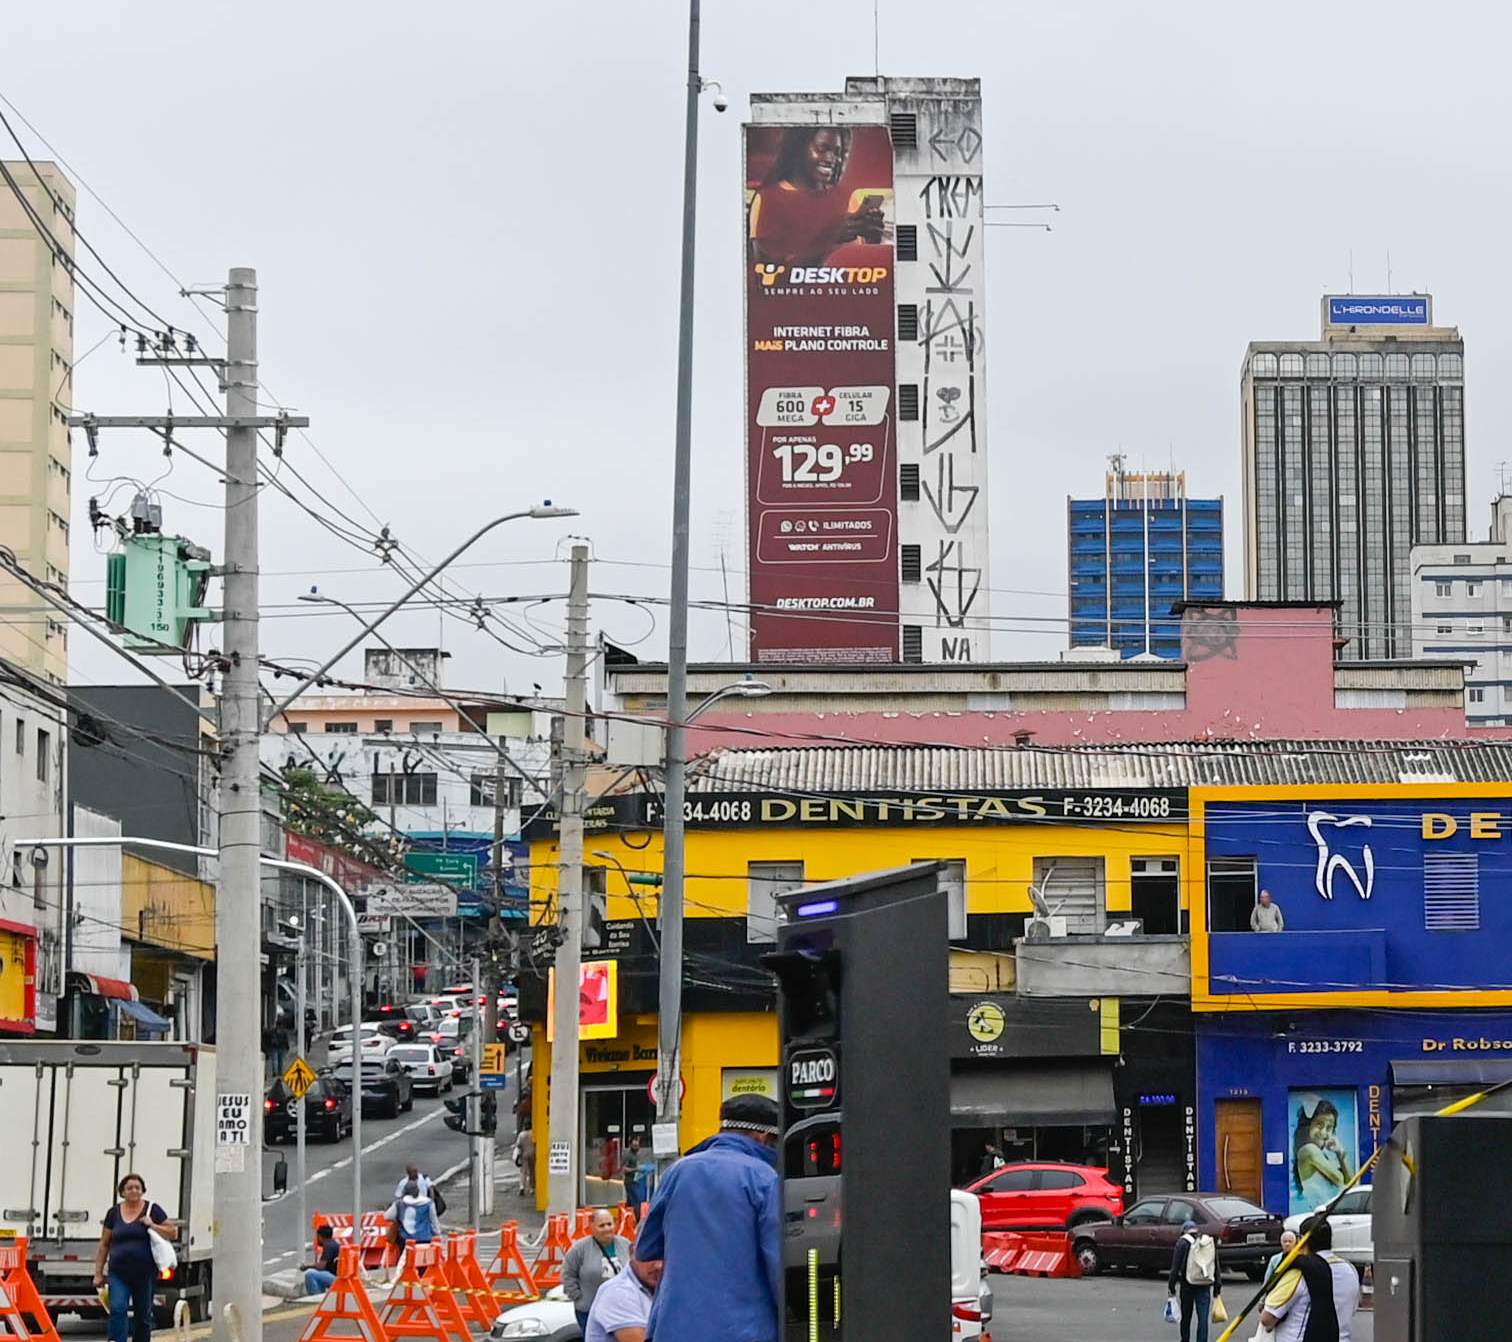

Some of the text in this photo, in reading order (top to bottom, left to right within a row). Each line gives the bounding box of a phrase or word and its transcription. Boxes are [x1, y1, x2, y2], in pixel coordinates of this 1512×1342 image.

[789, 266, 888, 284] DESKTOP
[764, 288, 805, 296] SEMPRE
[852, 287, 880, 295] LADO
[1332, 305, 1425, 315] L'HIRONDELLE
[773, 326, 870, 338] INTERNET FIBRA
[784, 340, 826, 351] PLANO
[827, 339, 889, 351] CONTROLE
[839, 391, 873, 399] CELULAR
[776, 400, 805, 413] 600
[848, 400, 864, 412] 15
[822, 521, 873, 531] ILIMITADOS
[776, 597, 875, 609] DESKTOP.COM.BR
[150, 622, 170, 632] 150
[760, 796, 1047, 822] DENTISTAS
[1063, 797, 1170, 818] F-3234-4068
[1299, 1041, 1363, 1053] 3233-3792
[1422, 1038, 1447, 1052] Dr
[791, 1058, 834, 1085] PARCO
[731, 1082, 767, 1093] dentário
[218, 1096, 249, 1107] JESUS
[222, 1108, 242, 1119] EU
[218, 1119, 247, 1130] AMO
[1123, 1108, 1133, 1194] DENTISTAS
[1185, 1106, 1195, 1192] DENTISTAS
